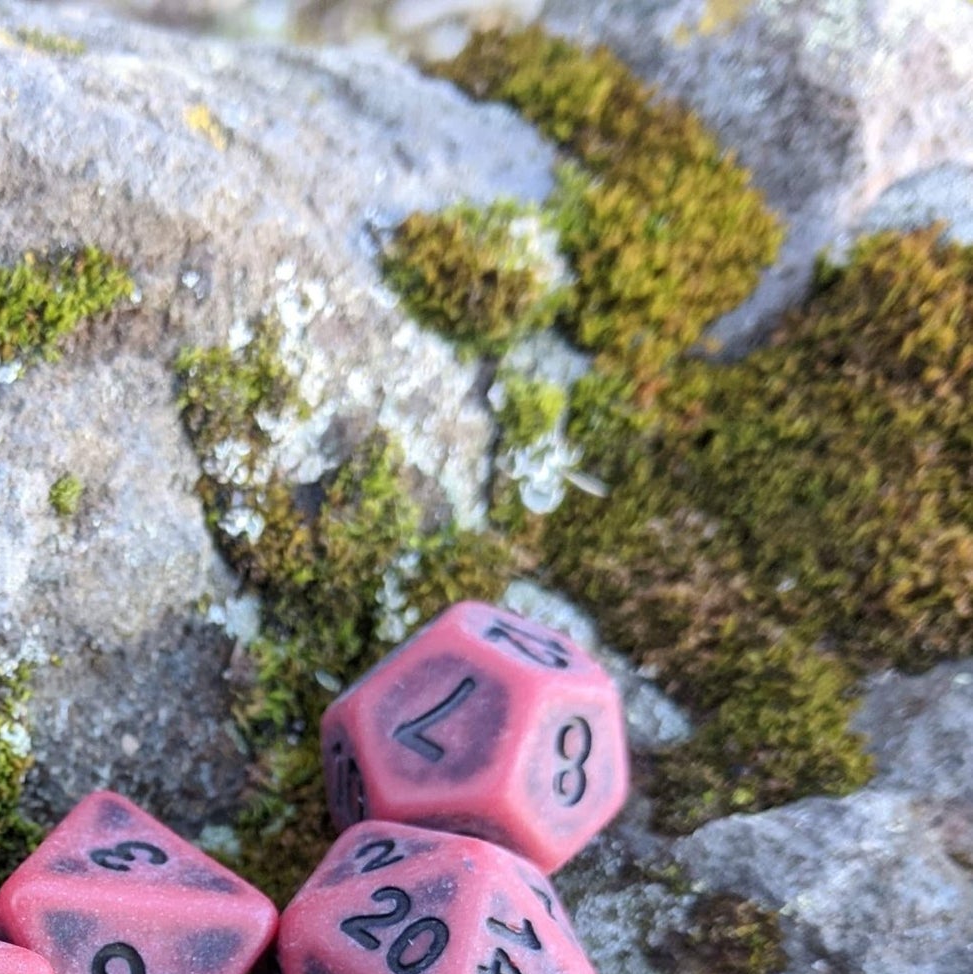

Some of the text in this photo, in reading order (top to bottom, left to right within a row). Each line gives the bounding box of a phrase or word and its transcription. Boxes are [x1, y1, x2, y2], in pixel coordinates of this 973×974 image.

[393, 676, 476, 762] 7
[553, 717, 592, 806] 8
[90, 840, 168, 871] 3
[355, 840, 403, 872] 2
